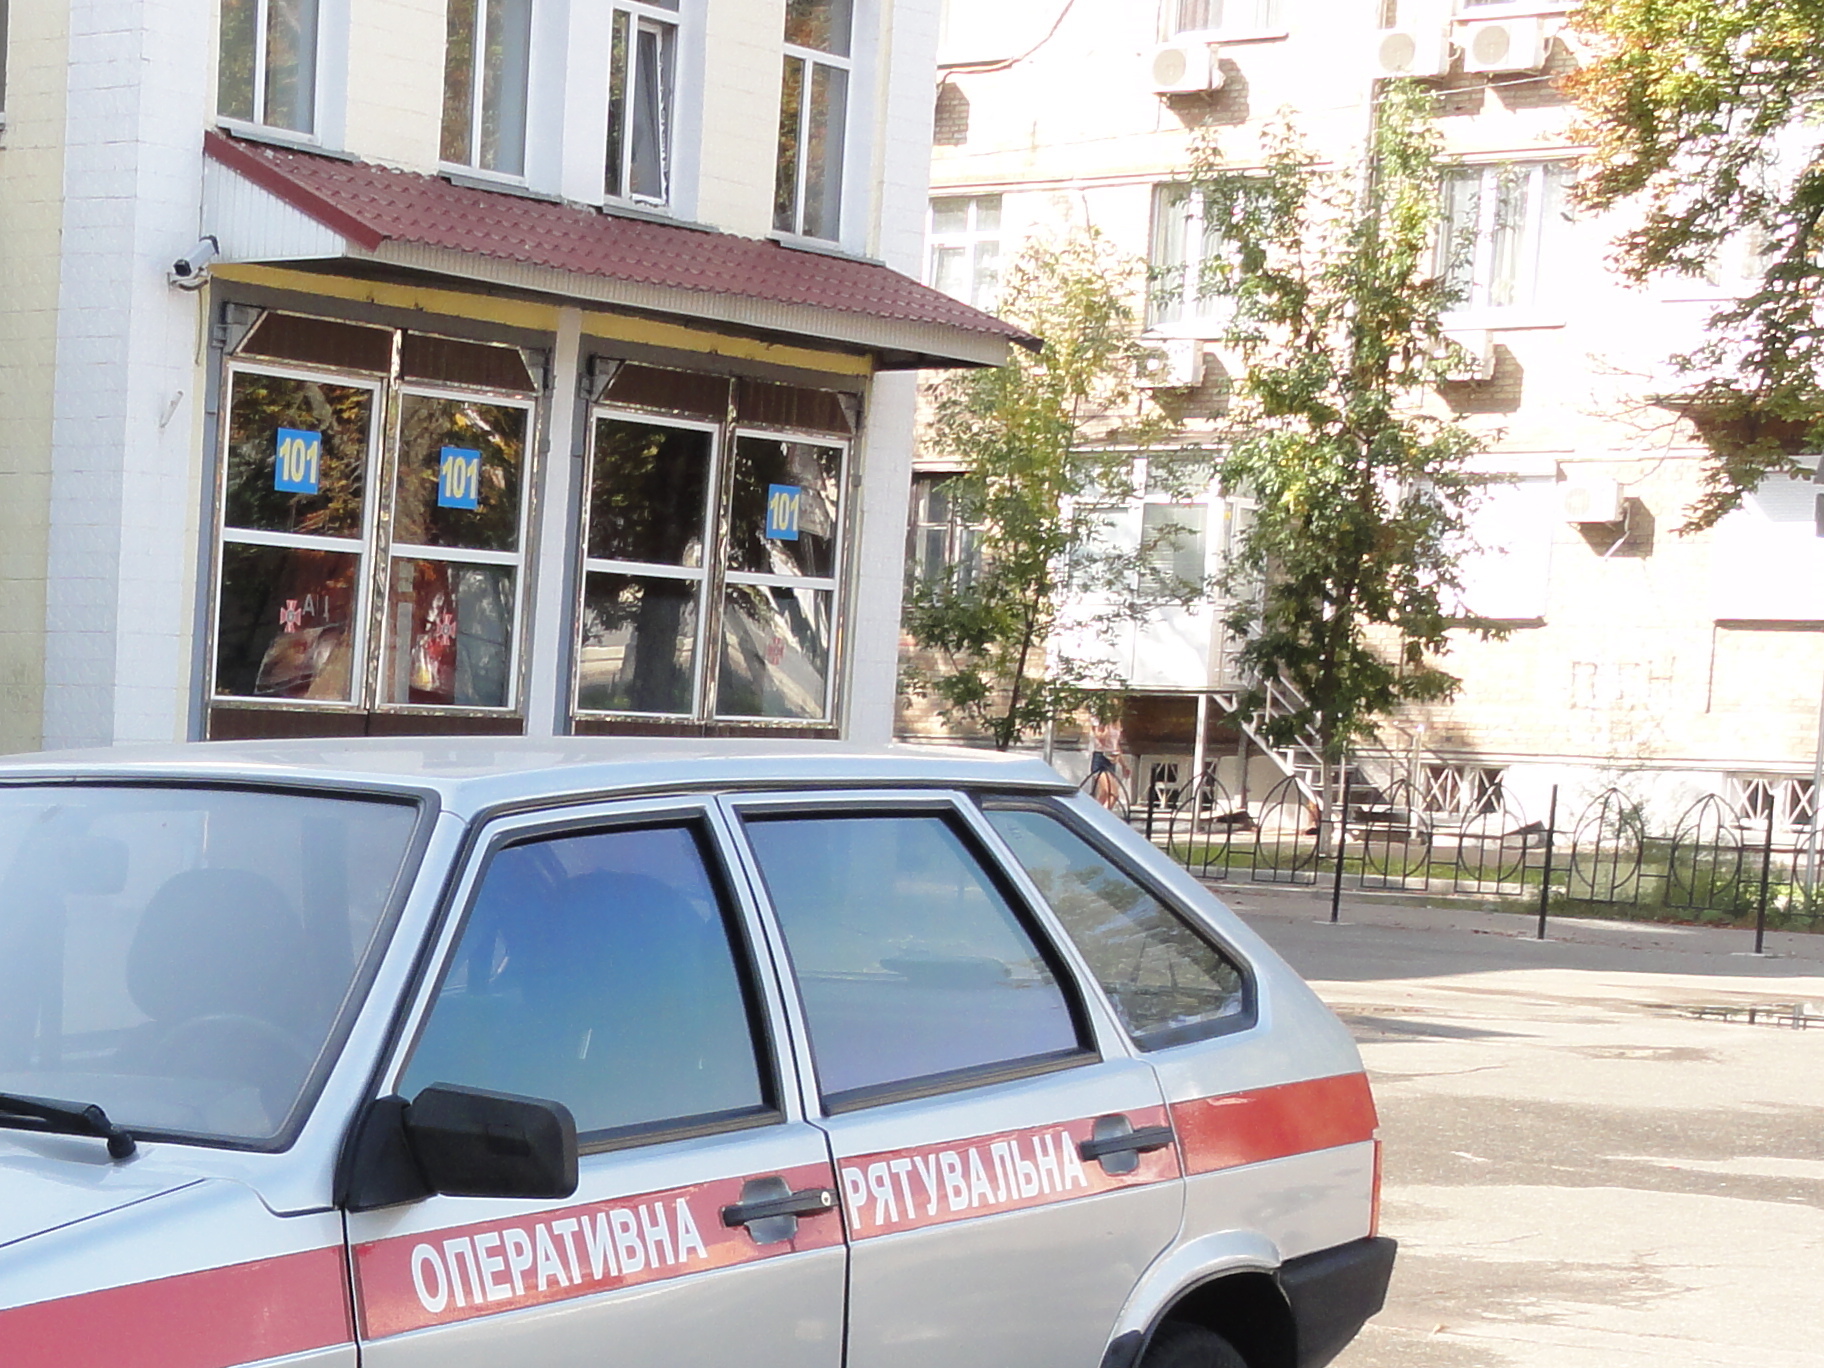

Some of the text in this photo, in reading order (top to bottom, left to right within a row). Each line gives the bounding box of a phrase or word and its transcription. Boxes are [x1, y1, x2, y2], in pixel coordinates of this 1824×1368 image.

[279, 437, 319, 484] 101
[442, 456, 479, 499] 101
[770, 492, 800, 531] 101
[411, 1131, 1088, 1313] ОПЕРАТИВНА РЯТУВАЛЬНА
